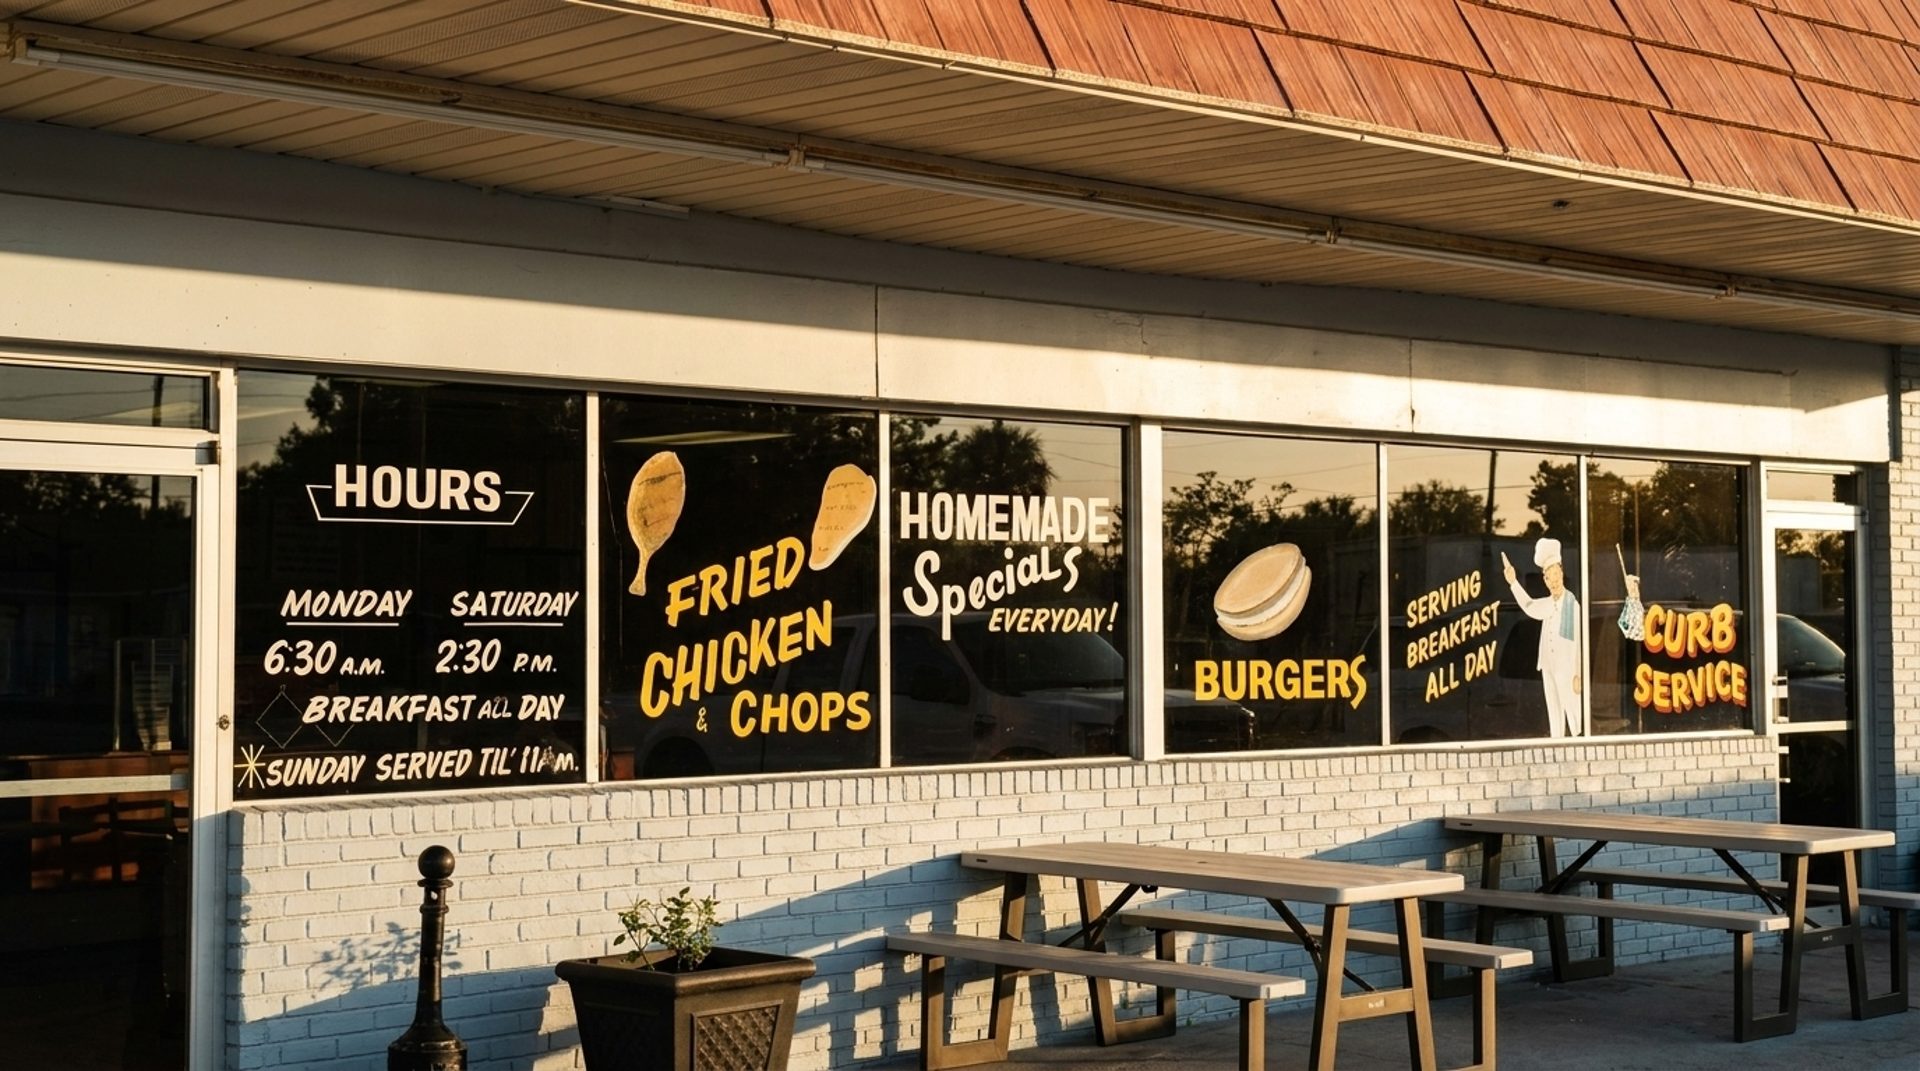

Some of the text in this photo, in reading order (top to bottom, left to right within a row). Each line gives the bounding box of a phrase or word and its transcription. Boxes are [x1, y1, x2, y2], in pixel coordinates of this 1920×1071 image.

[336, 464, 501, 512] HOURS
[901, 491, 1109, 543] HOMEMADE
[281, 590, 412, 617] MONDAY
[451, 591, 579, 617] SATURDAY
[665, 537, 805, 627] FRIED
[1407, 570, 1482, 628] SERVING
[989, 602, 1118, 632] EVERYDAY!
[1407, 600, 1500, 669] BREAKFAST
[1644, 603, 1736, 659] CURB
[264, 639, 385, 676] 6:30 A.M.
[435, 639, 557, 674] 2:30 P.M.
[640, 600, 832, 718] CHICKEN
[1425, 641, 1497, 703] ALL DAY
[1195, 655, 1366, 709] BURGERS
[1634, 660, 1748, 713] SERVICE
[302, 693, 565, 723] BREAKFAST ALL DAY
[696, 690, 872, 737] & CHOPS
[266, 755, 366, 787] SUNDAY
[376, 749, 472, 781] SERVED
